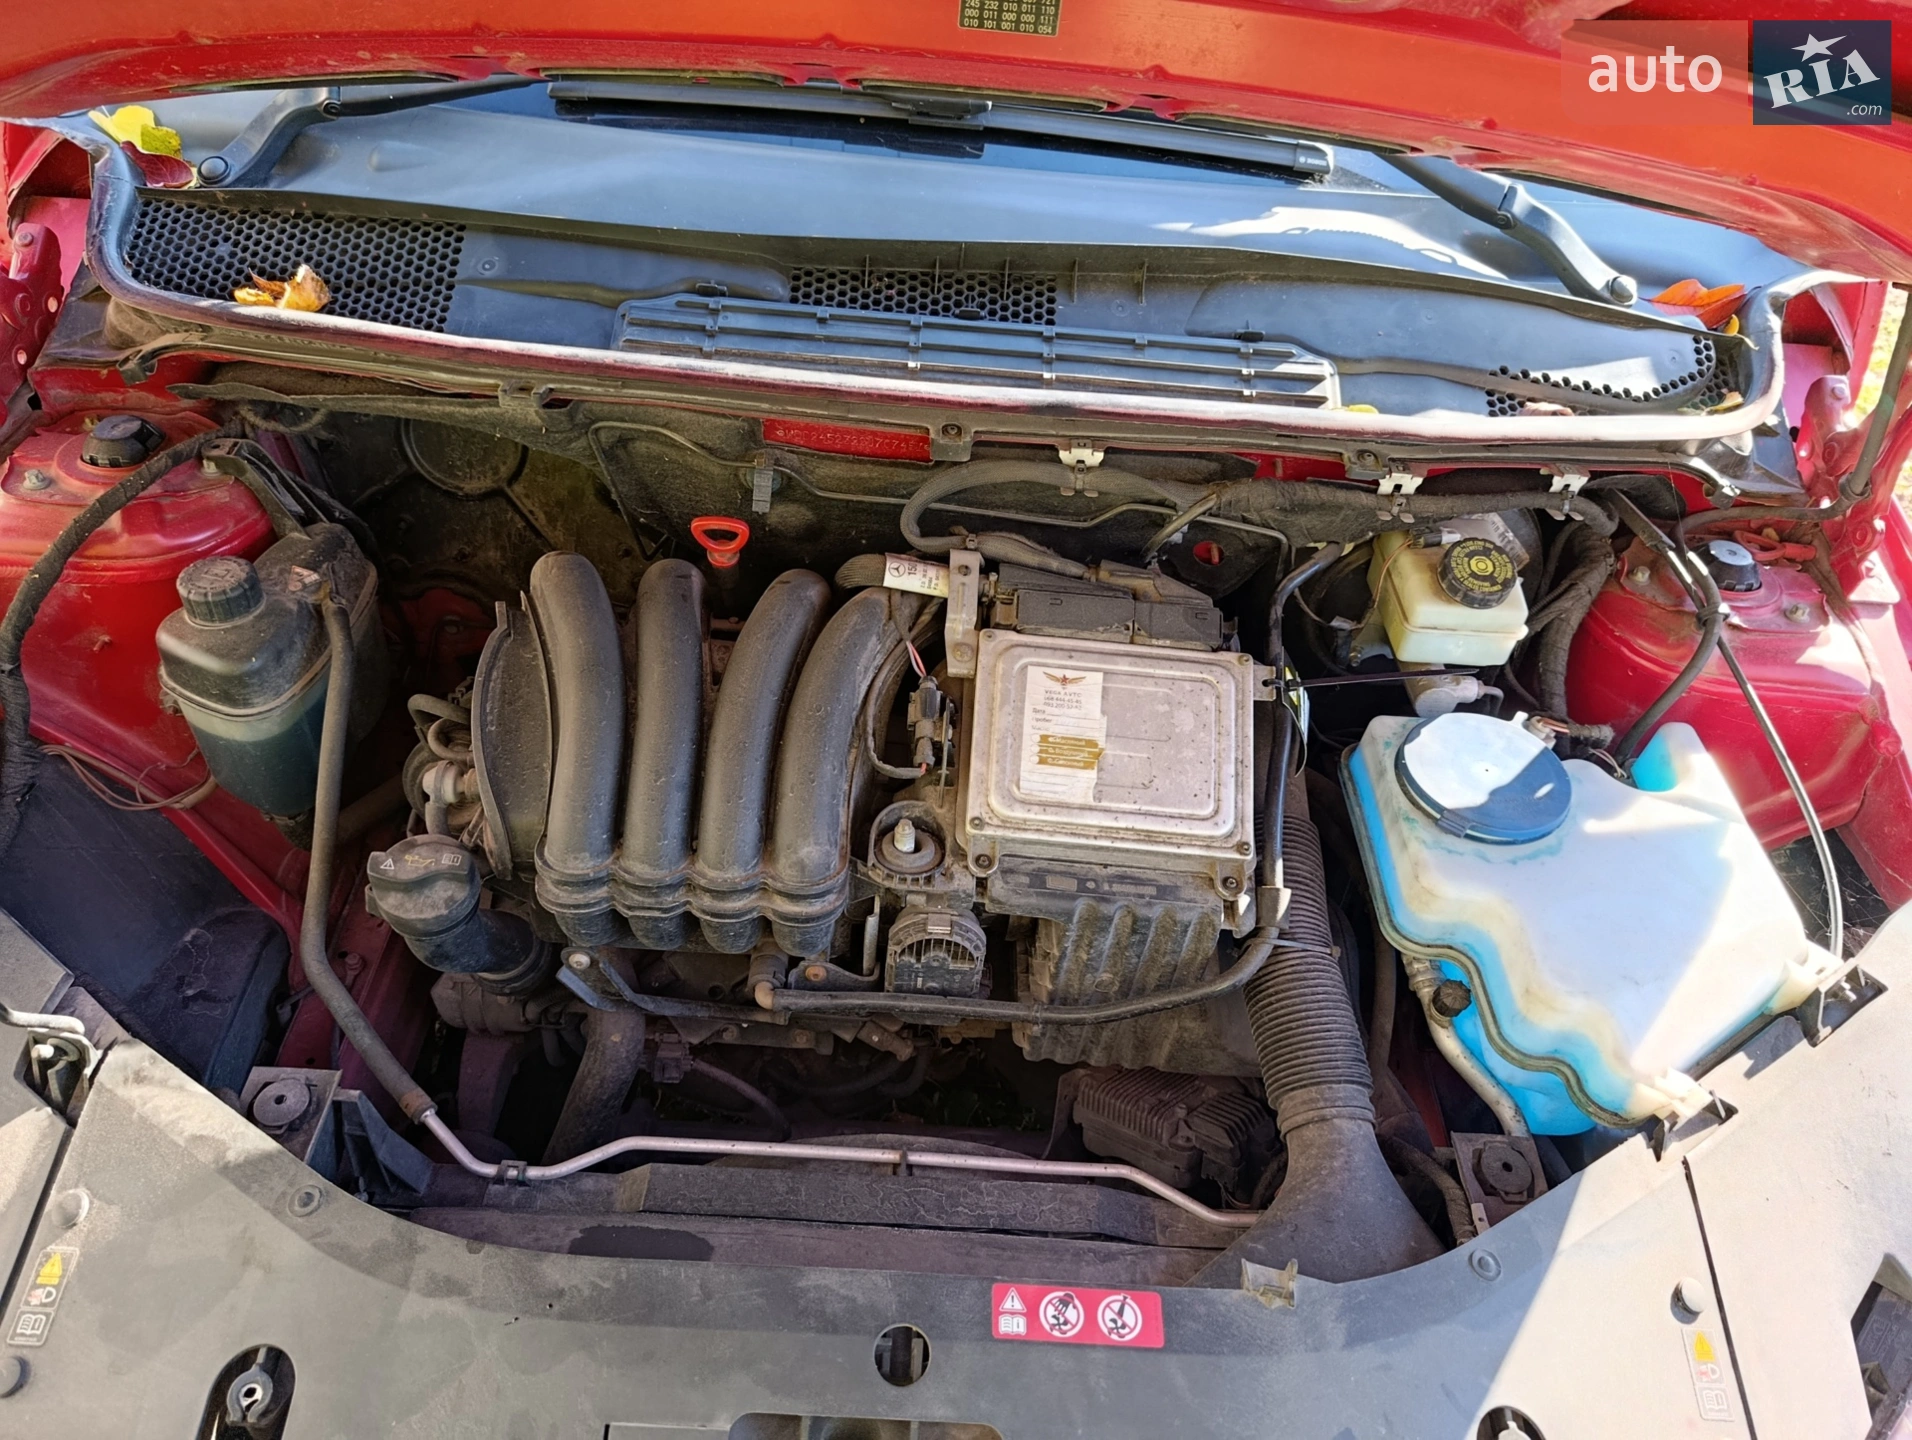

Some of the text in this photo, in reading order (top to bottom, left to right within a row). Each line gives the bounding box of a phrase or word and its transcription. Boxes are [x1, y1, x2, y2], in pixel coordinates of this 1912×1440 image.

[965, 0, 1055, 15] 245 232 010 011 110
[964, 9, 1053, 24] 000 011 000 000 111
[963, 18, 1052, 34] 010 101 001 010 054
